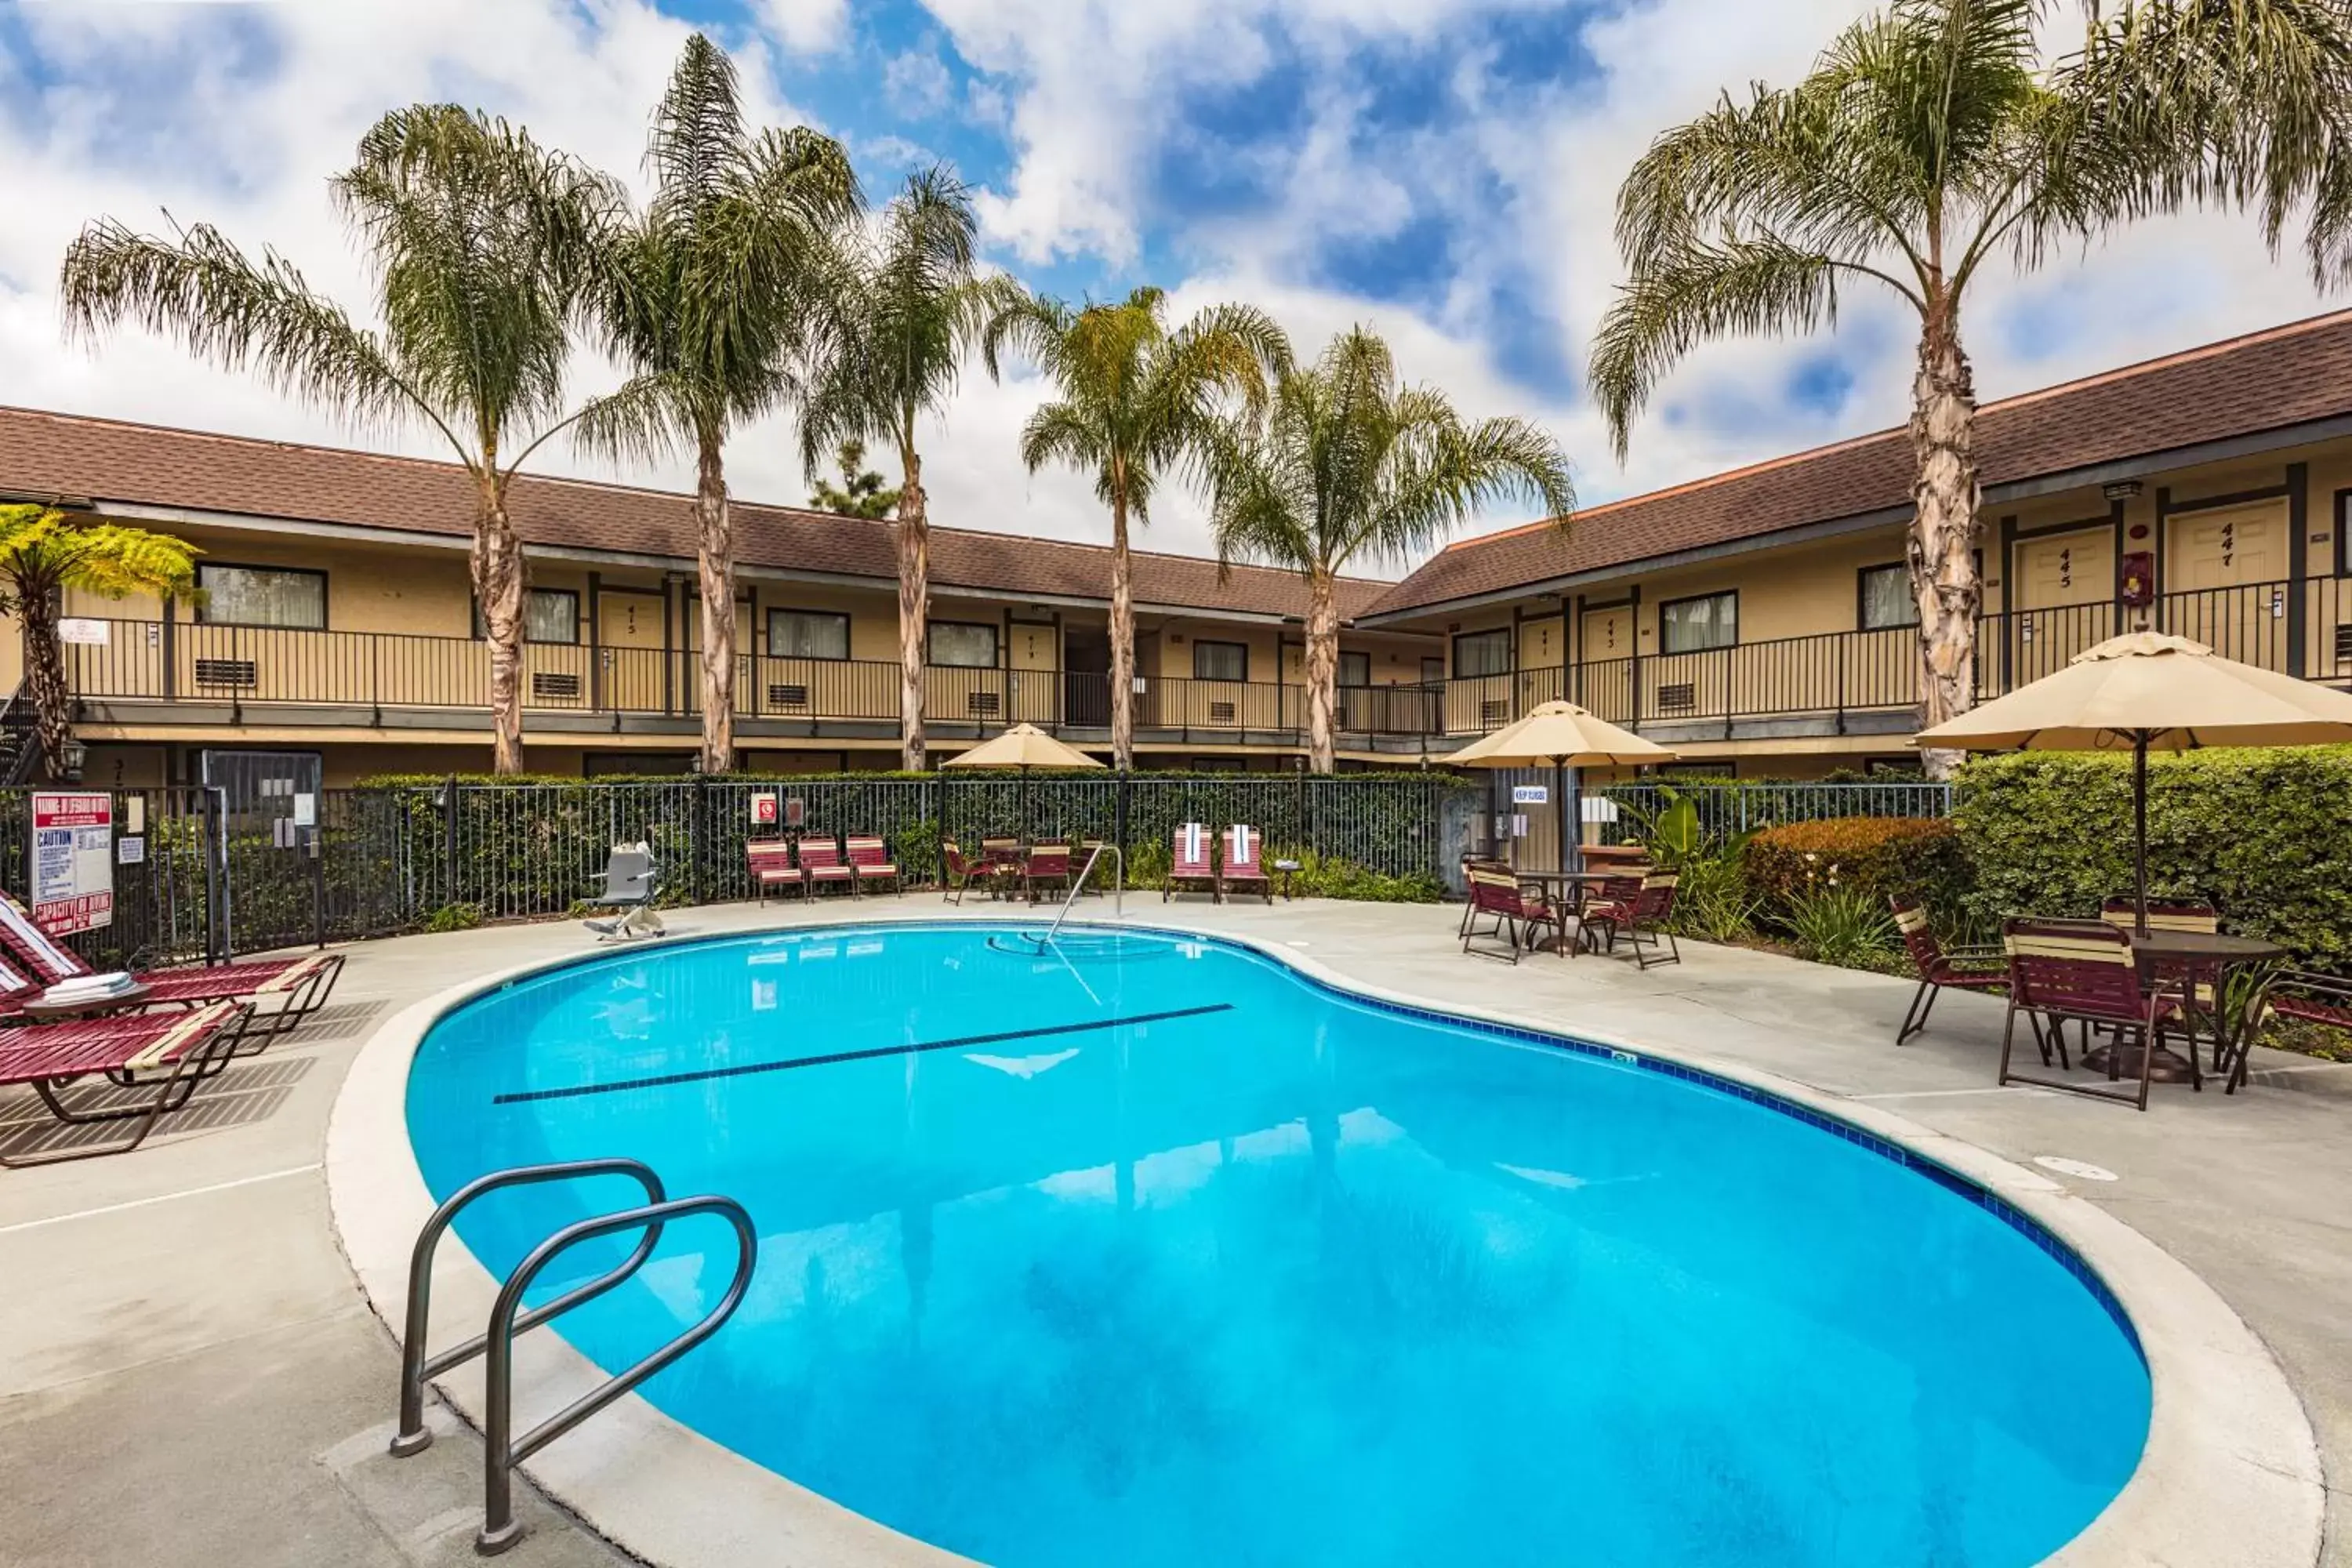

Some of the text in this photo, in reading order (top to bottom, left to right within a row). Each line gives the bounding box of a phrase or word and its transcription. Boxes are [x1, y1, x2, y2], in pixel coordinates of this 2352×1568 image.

[2221, 522, 2234, 568] 447
[2060, 548, 2071, 589] 445
[38, 829, 71, 848] CAUTION
[37, 900, 74, 923] CAPACITY
